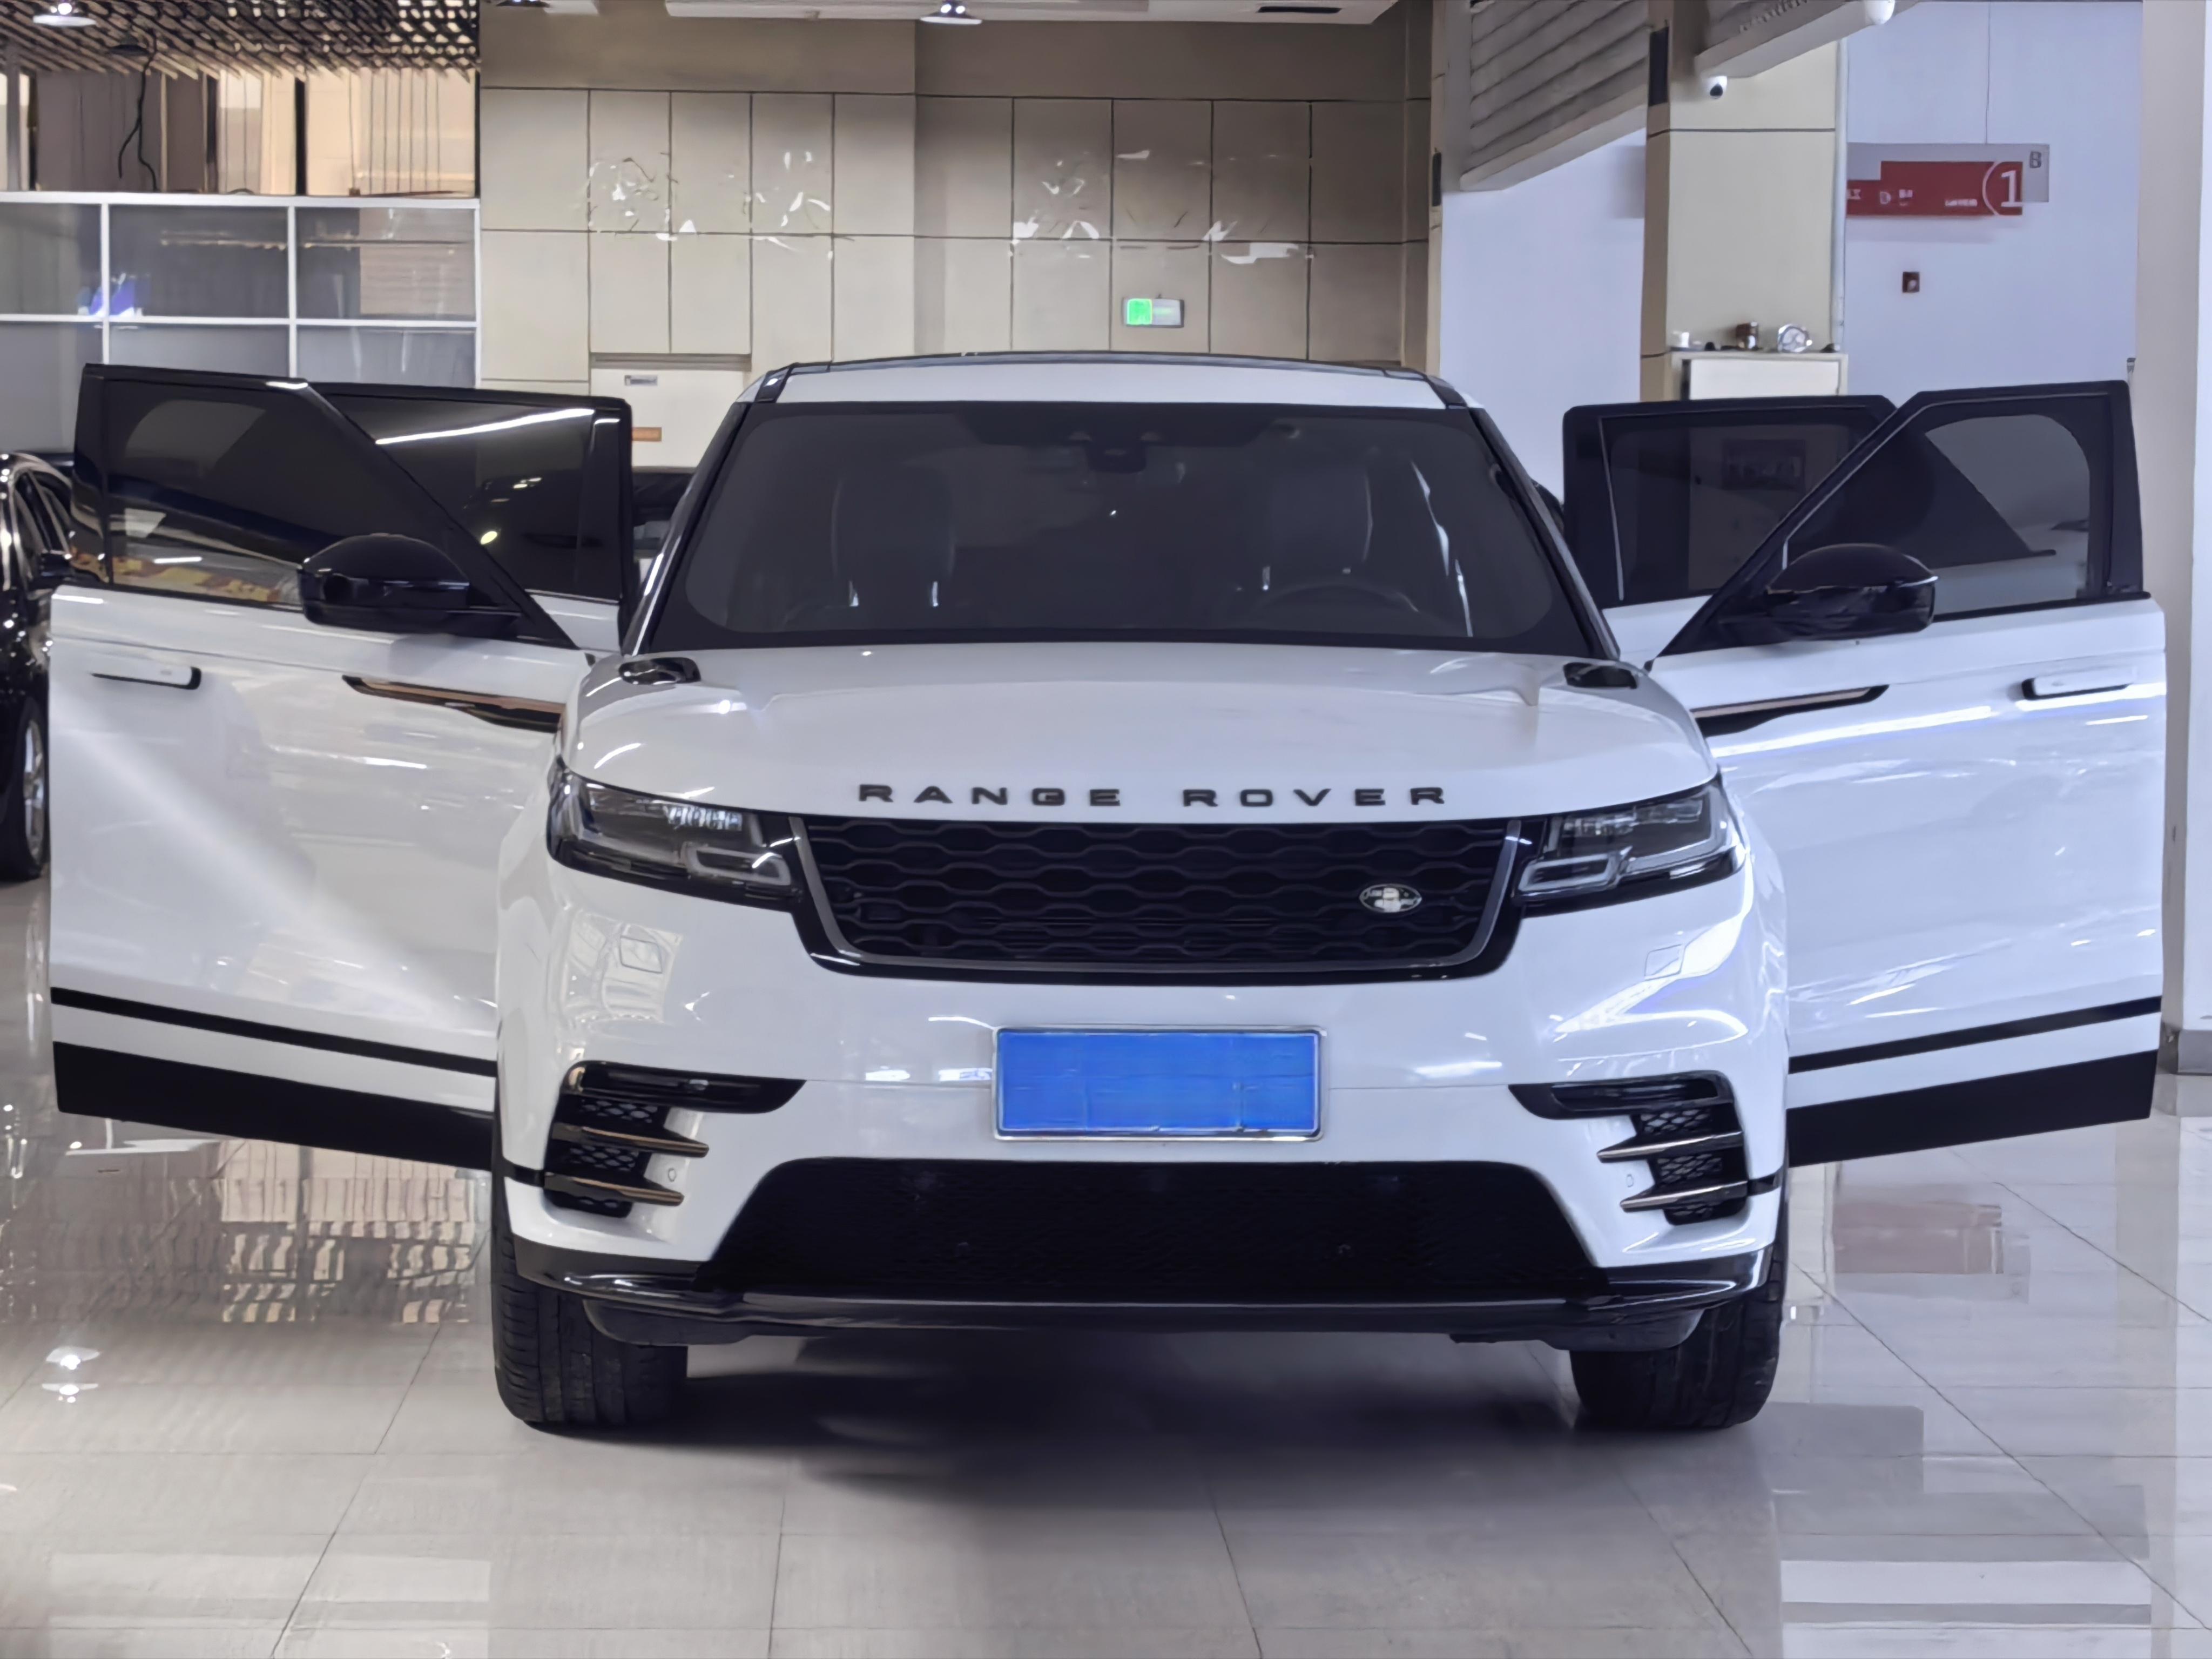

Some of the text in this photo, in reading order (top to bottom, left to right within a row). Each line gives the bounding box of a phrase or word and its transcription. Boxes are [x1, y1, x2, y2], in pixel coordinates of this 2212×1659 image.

[2029, 151, 2042, 168] B
[2000, 170, 2023, 207] 1
[859, 784, 1445, 808] RANGE ROVER
